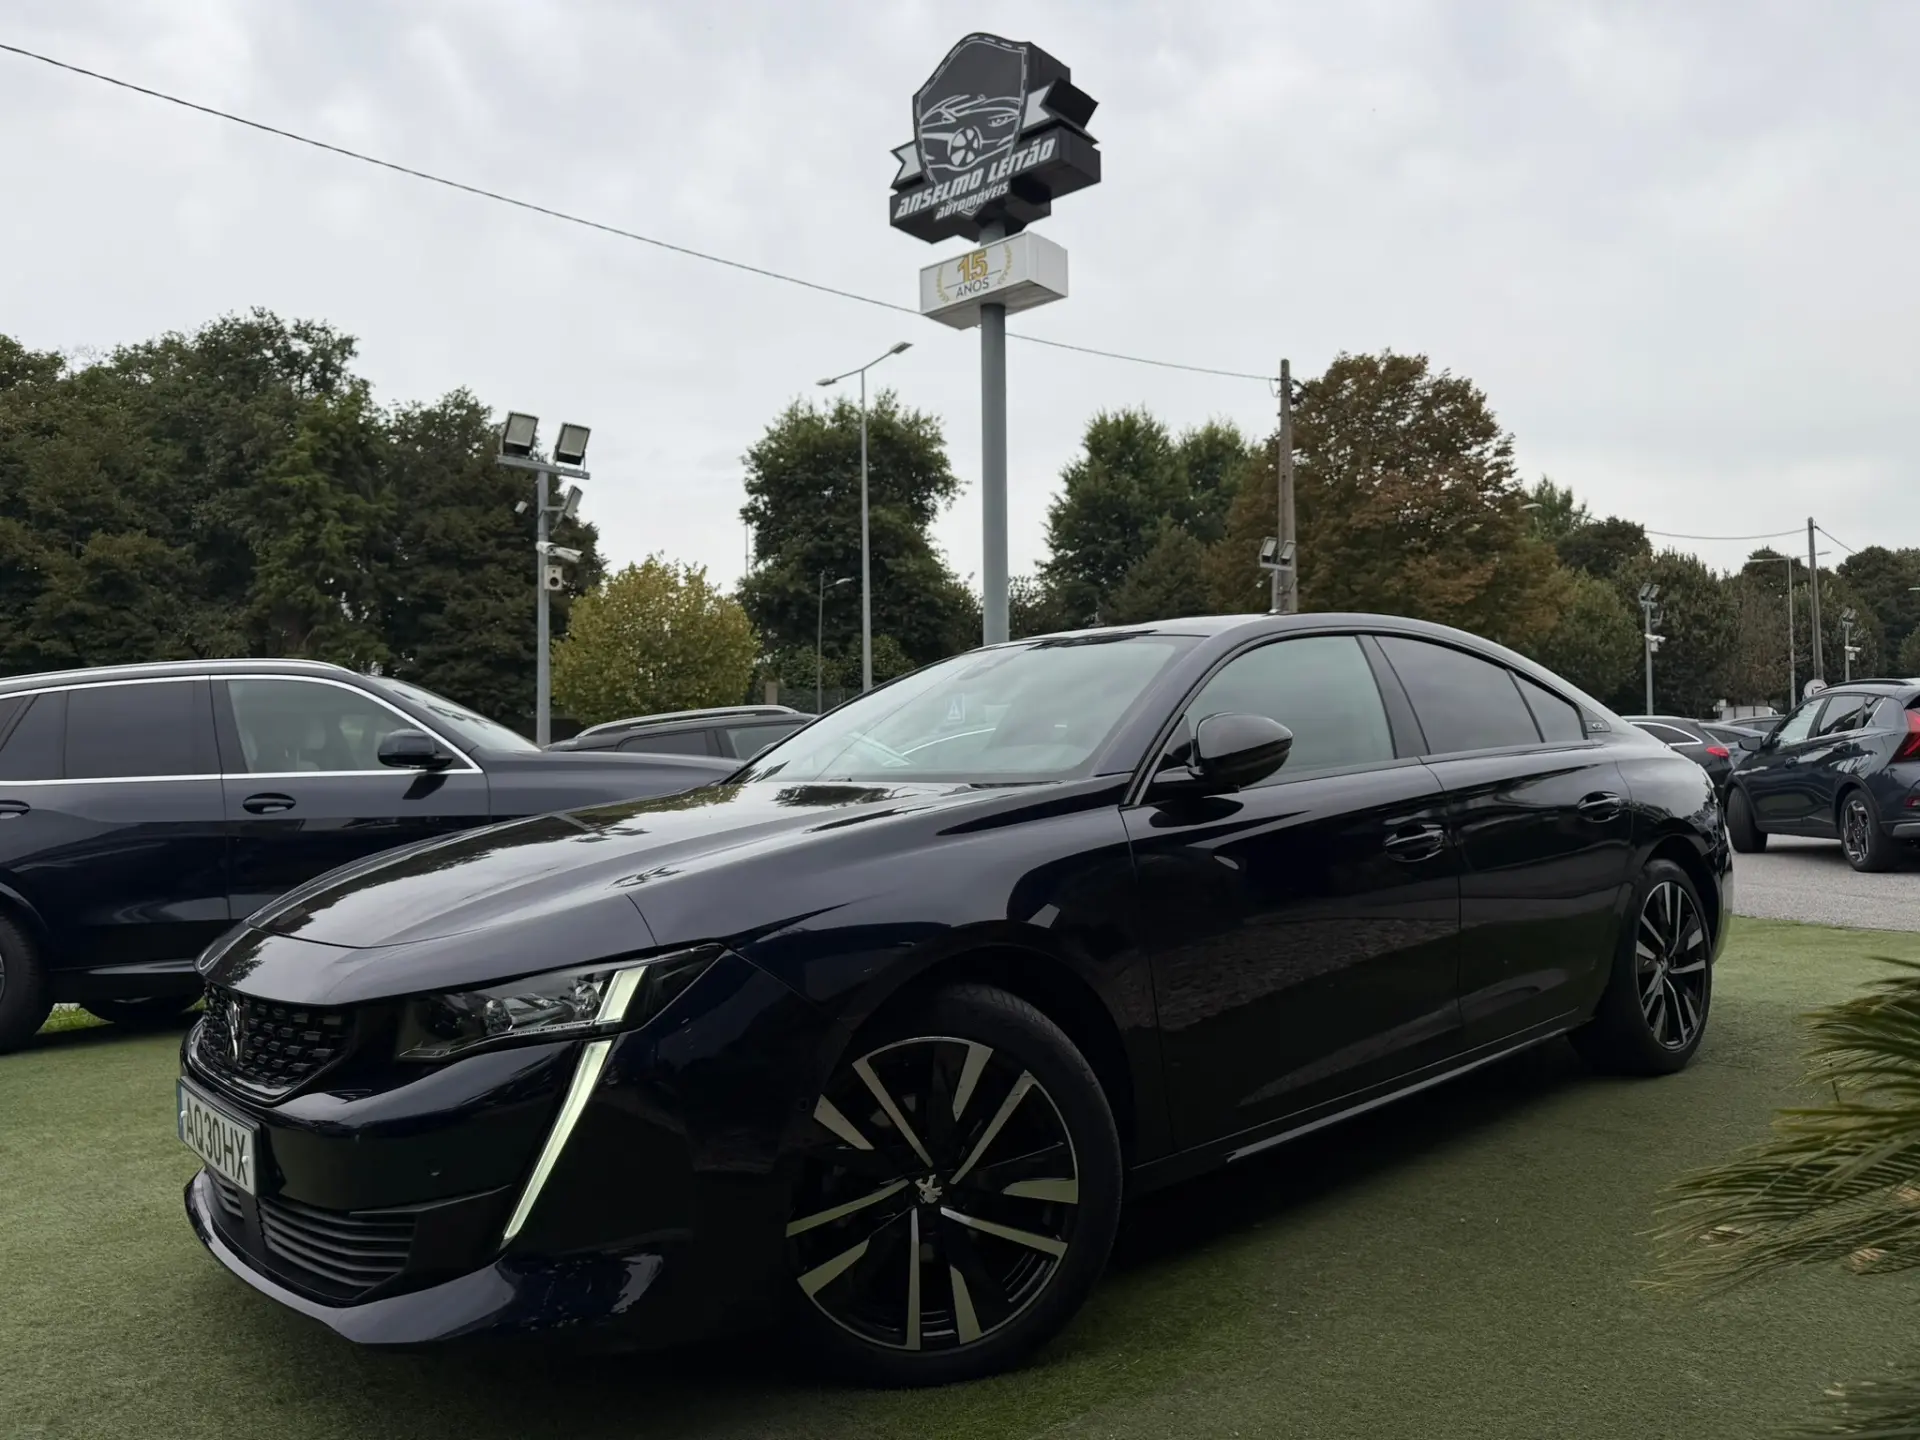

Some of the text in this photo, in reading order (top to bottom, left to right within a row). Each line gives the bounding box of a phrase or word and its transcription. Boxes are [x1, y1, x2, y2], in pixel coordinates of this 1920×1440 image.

[895, 138, 1056, 219] ANSELMO LEITÃO
[957, 249, 989, 282] 15
[956, 277, 990, 298] ANOS
